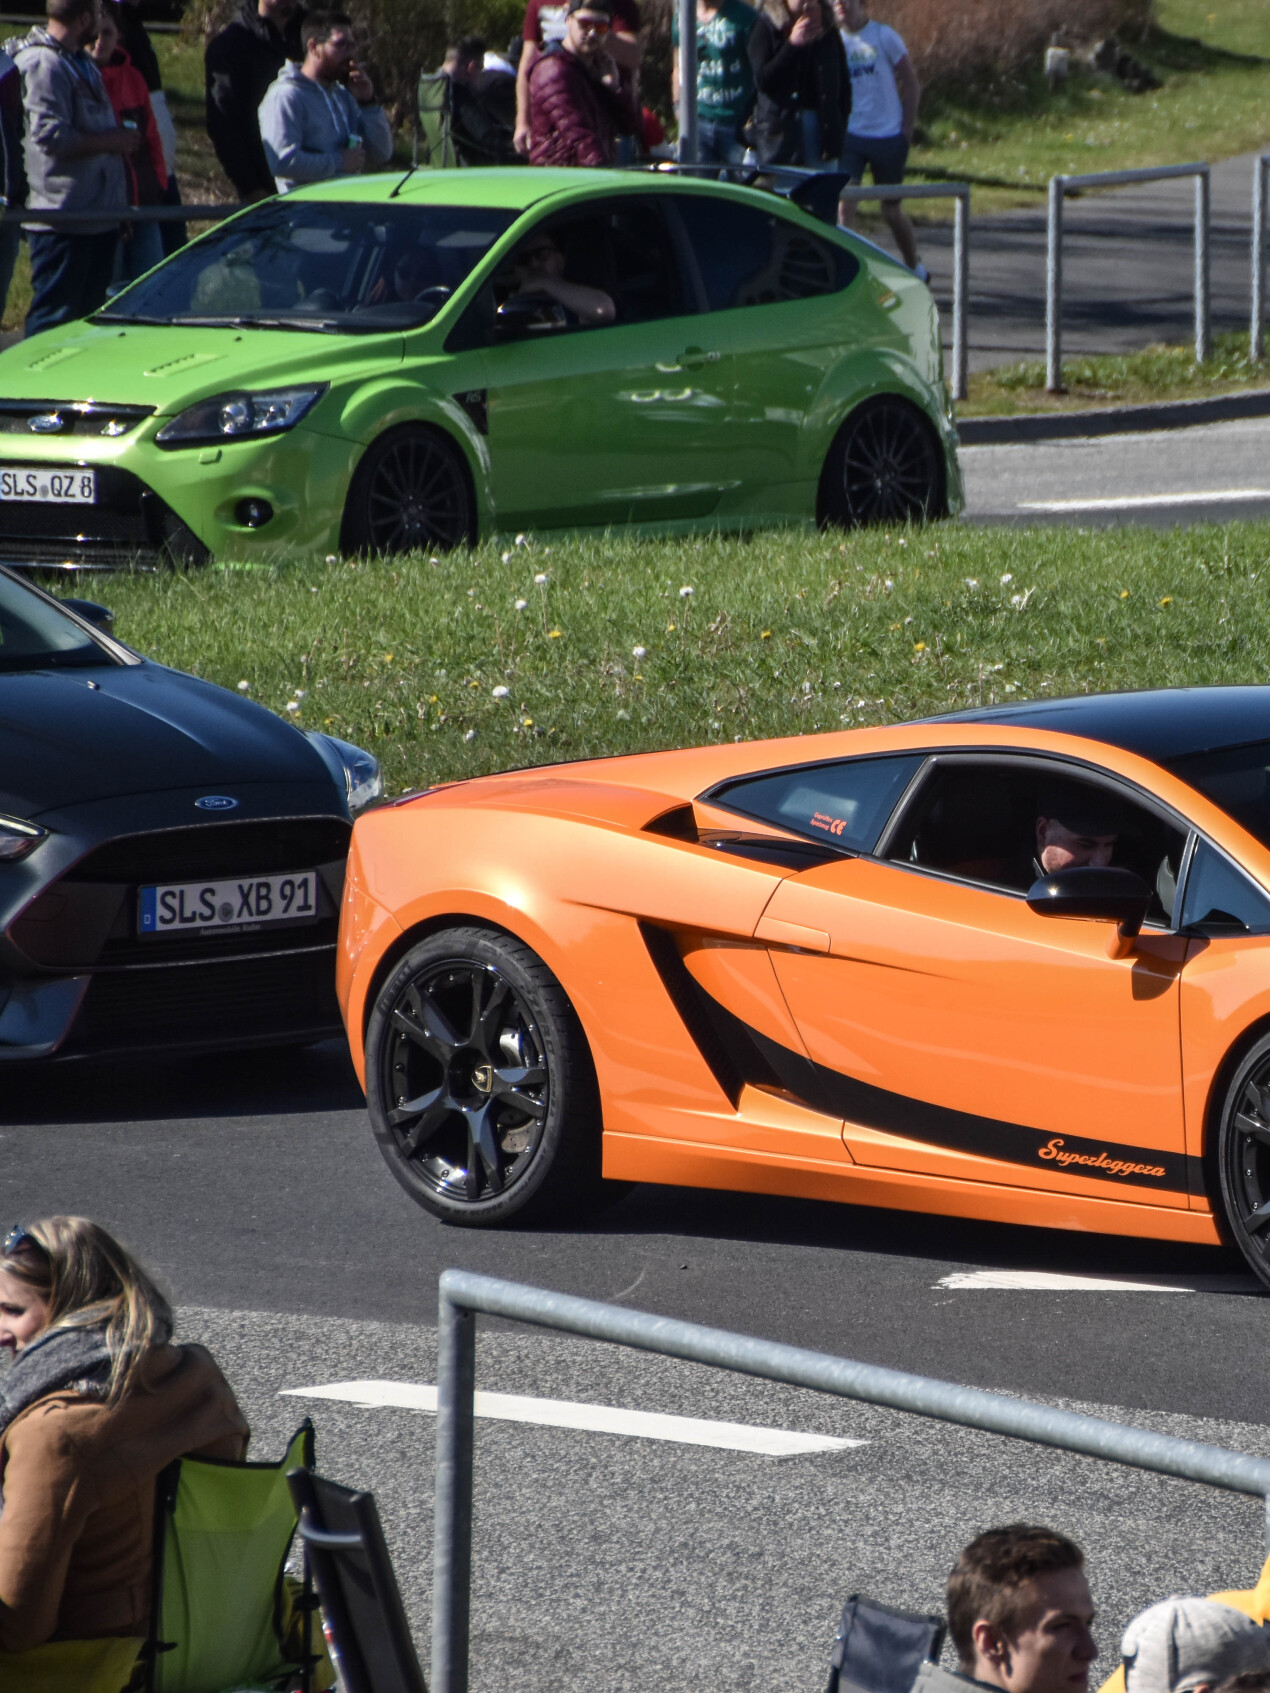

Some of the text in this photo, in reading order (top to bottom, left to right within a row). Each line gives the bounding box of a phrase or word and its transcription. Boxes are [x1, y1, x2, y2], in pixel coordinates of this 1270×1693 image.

[1, 472, 93, 499] SLS QZ 8
[143, 876, 313, 925] D SLS XB 91
[1038, 1138, 1167, 1177] Superleggera
